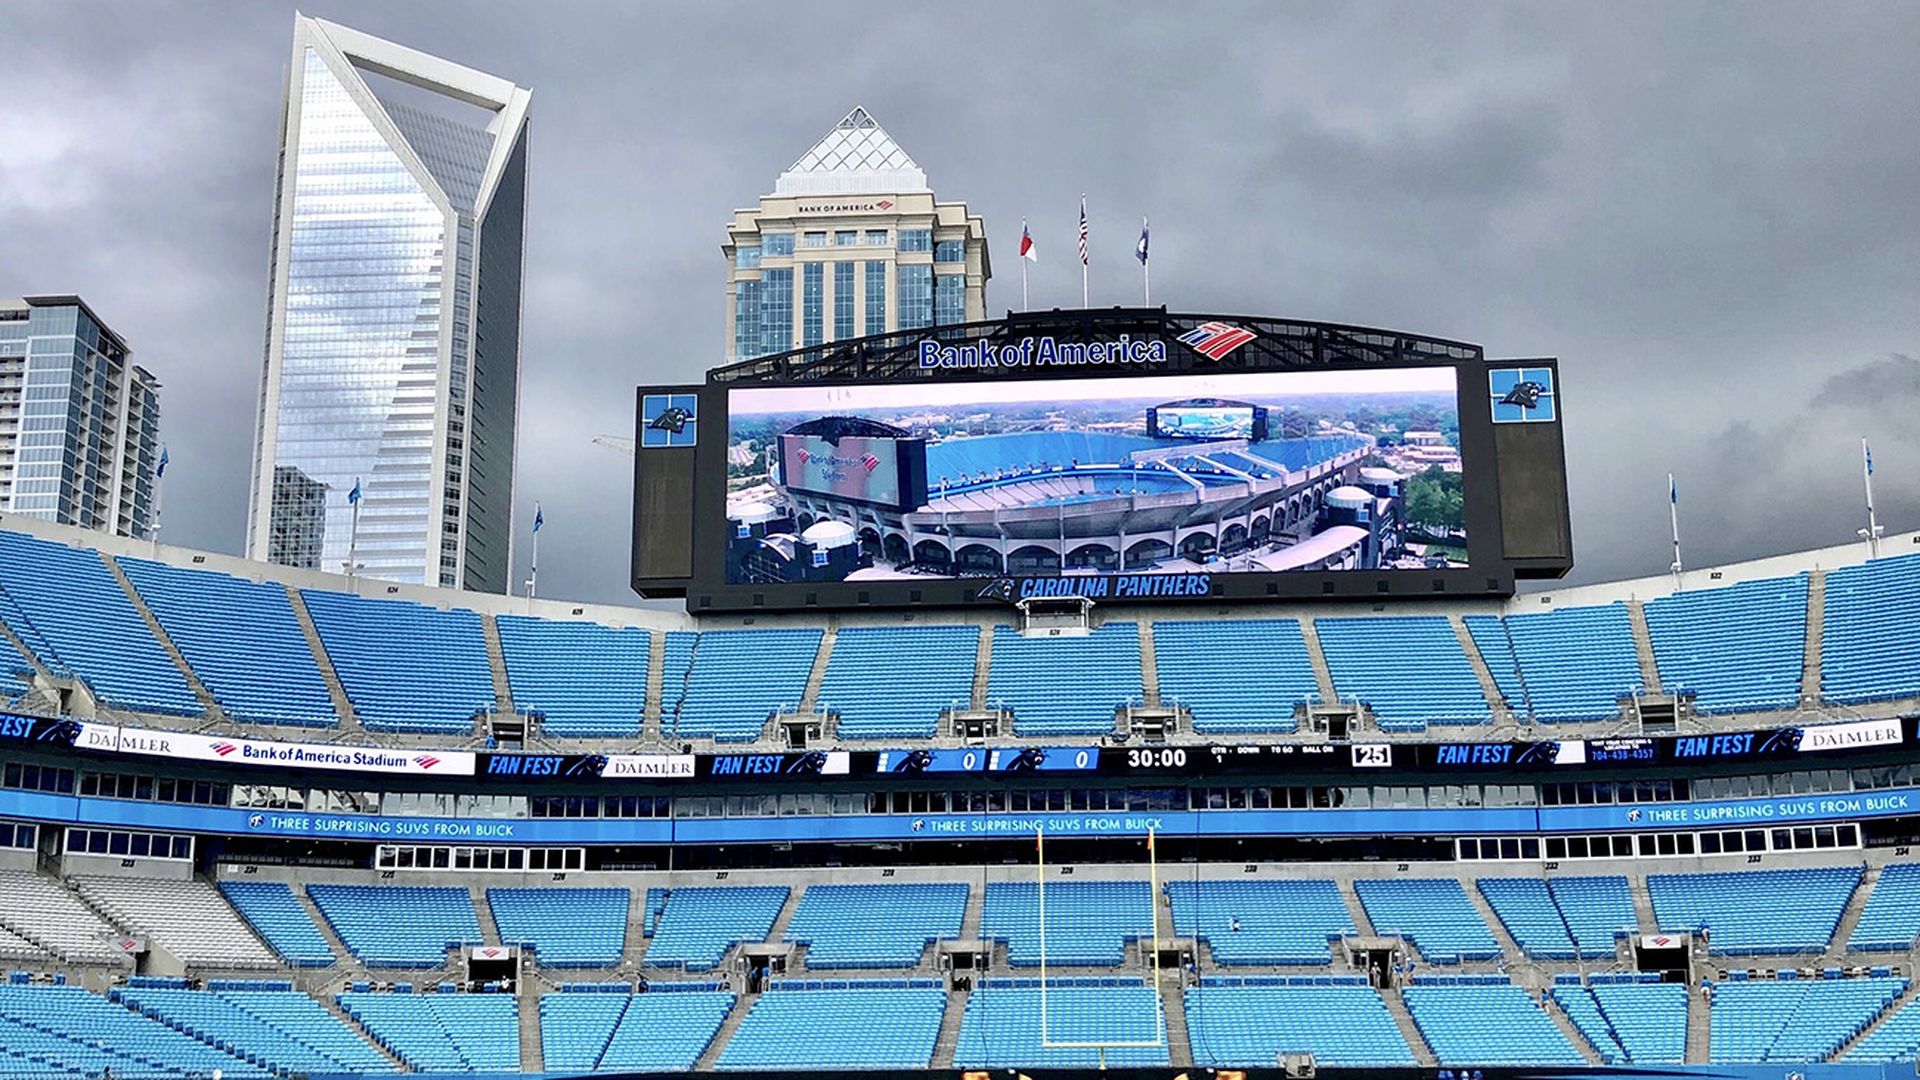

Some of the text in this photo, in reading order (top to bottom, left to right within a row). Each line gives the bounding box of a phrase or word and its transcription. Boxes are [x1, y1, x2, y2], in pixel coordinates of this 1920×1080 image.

[919, 334, 1167, 369] Bank of America
[1020, 575, 1210, 598] CAROLINA PANTHERS
[89, 732, 172, 753] DAIMLER
[1674, 734, 1755, 757] FAN FEST
[1813, 728, 1899, 746] DAIMLER
[243, 744, 407, 767] Bank of America Stadium
[962, 752, 976, 770] 0
[1075, 751, 1089, 768] 0
[1128, 749, 1187, 767] 30:00
[1216, 754, 1222, 763] 1
[1359, 746, 1385, 764] 25
[1436, 745, 1513, 763] FAN FEST
[488, 756, 564, 775] FAN FEST
[615, 763, 691, 774] DAIMLER
[711, 755, 784, 774] FAN FEST
[1649, 796, 1908, 823] THREE SURPRISING SUVS FROM BUICK
[271, 817, 514, 837] THREE SURPRISING SUVS FROM BUICK
[931, 818, 1162, 832] THREE SURPRISING SUVS FROM BUICK
